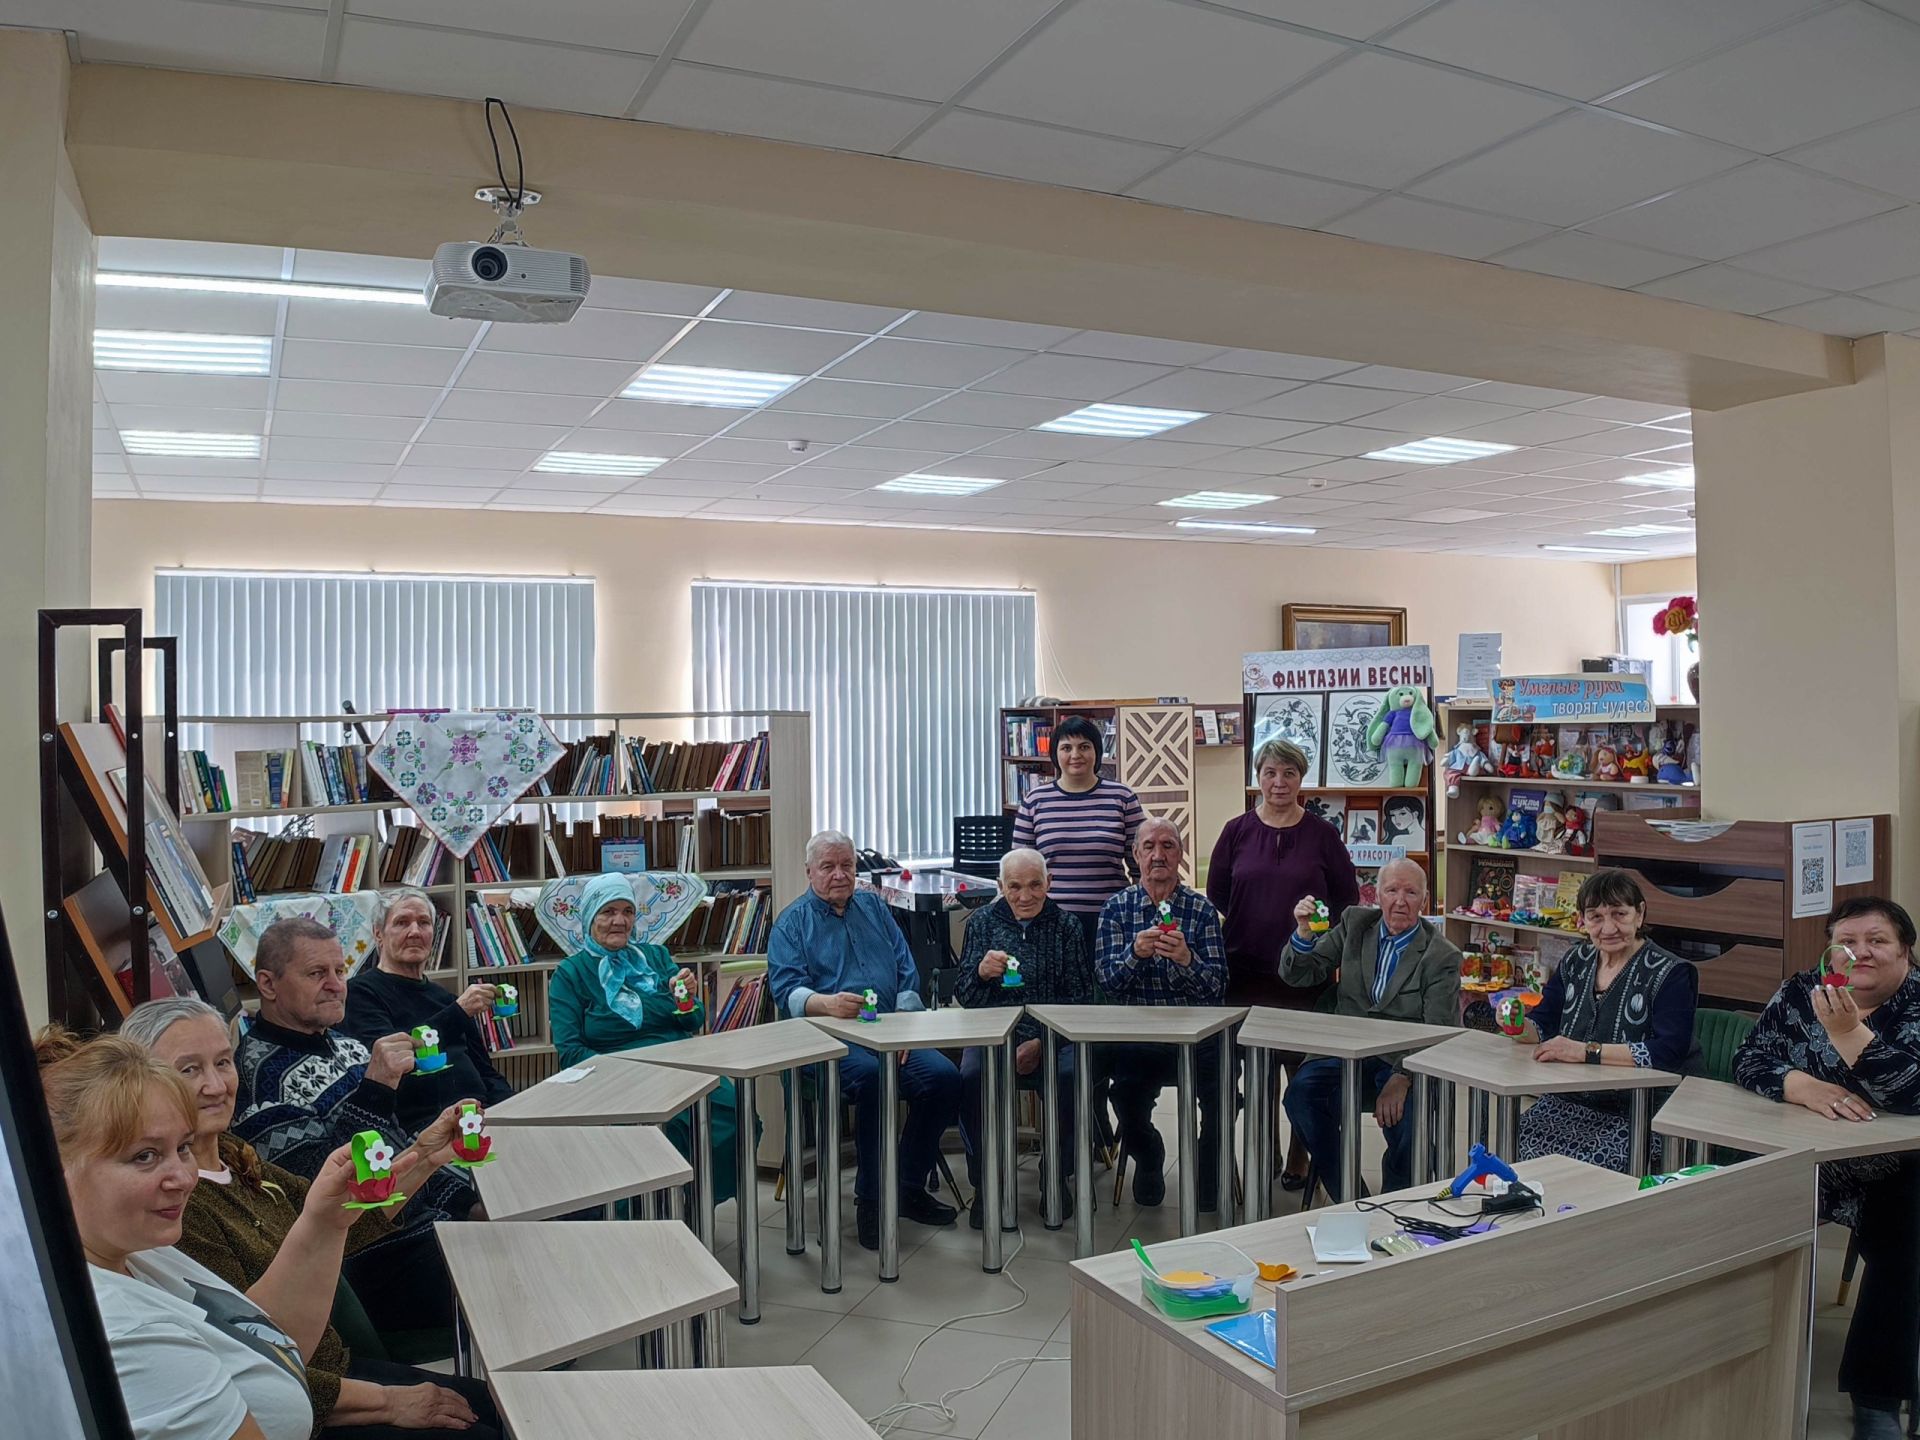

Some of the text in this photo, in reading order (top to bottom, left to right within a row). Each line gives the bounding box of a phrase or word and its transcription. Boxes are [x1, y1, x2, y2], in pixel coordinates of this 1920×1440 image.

[1272, 665, 1427, 689] ФАНТАЗИИ ВЕСНЫ
[1518, 679, 1624, 698] Умелые руки
[1552, 700, 1652, 719] творят чудеса
[1357, 850, 1392, 861] КРАСОТУ
